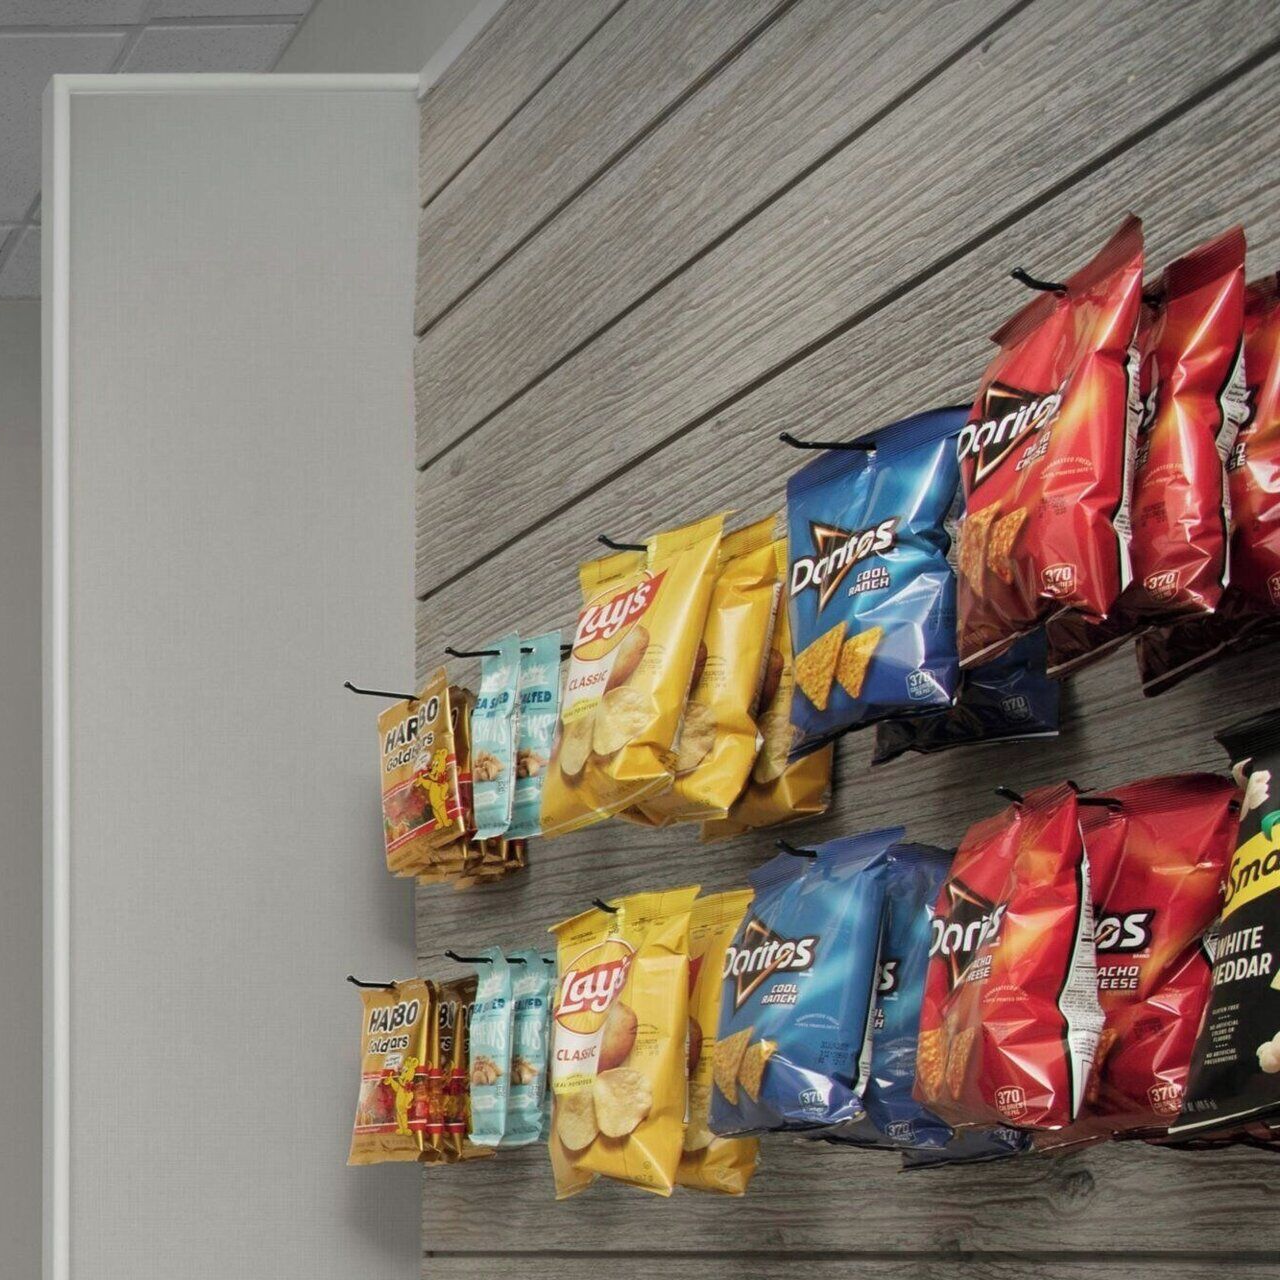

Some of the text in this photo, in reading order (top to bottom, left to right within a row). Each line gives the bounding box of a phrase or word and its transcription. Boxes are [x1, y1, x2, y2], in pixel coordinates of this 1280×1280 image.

[856, 567, 889, 583] COOL
[1148, 574, 1176, 590] 370
[847, 577, 890, 597] RANCH
[574, 580, 651, 650] Lay's
[567, 668, 608, 692] CLASSIC
[1216, 925, 1264, 959] WHITE
[722, 937, 815, 980] Doritos
[1097, 965, 1139, 977] ACHO
[771, 984, 798, 994] COOL
[760, 994, 797, 1004] RANCH
[997, 1089, 1020, 1104] 370
